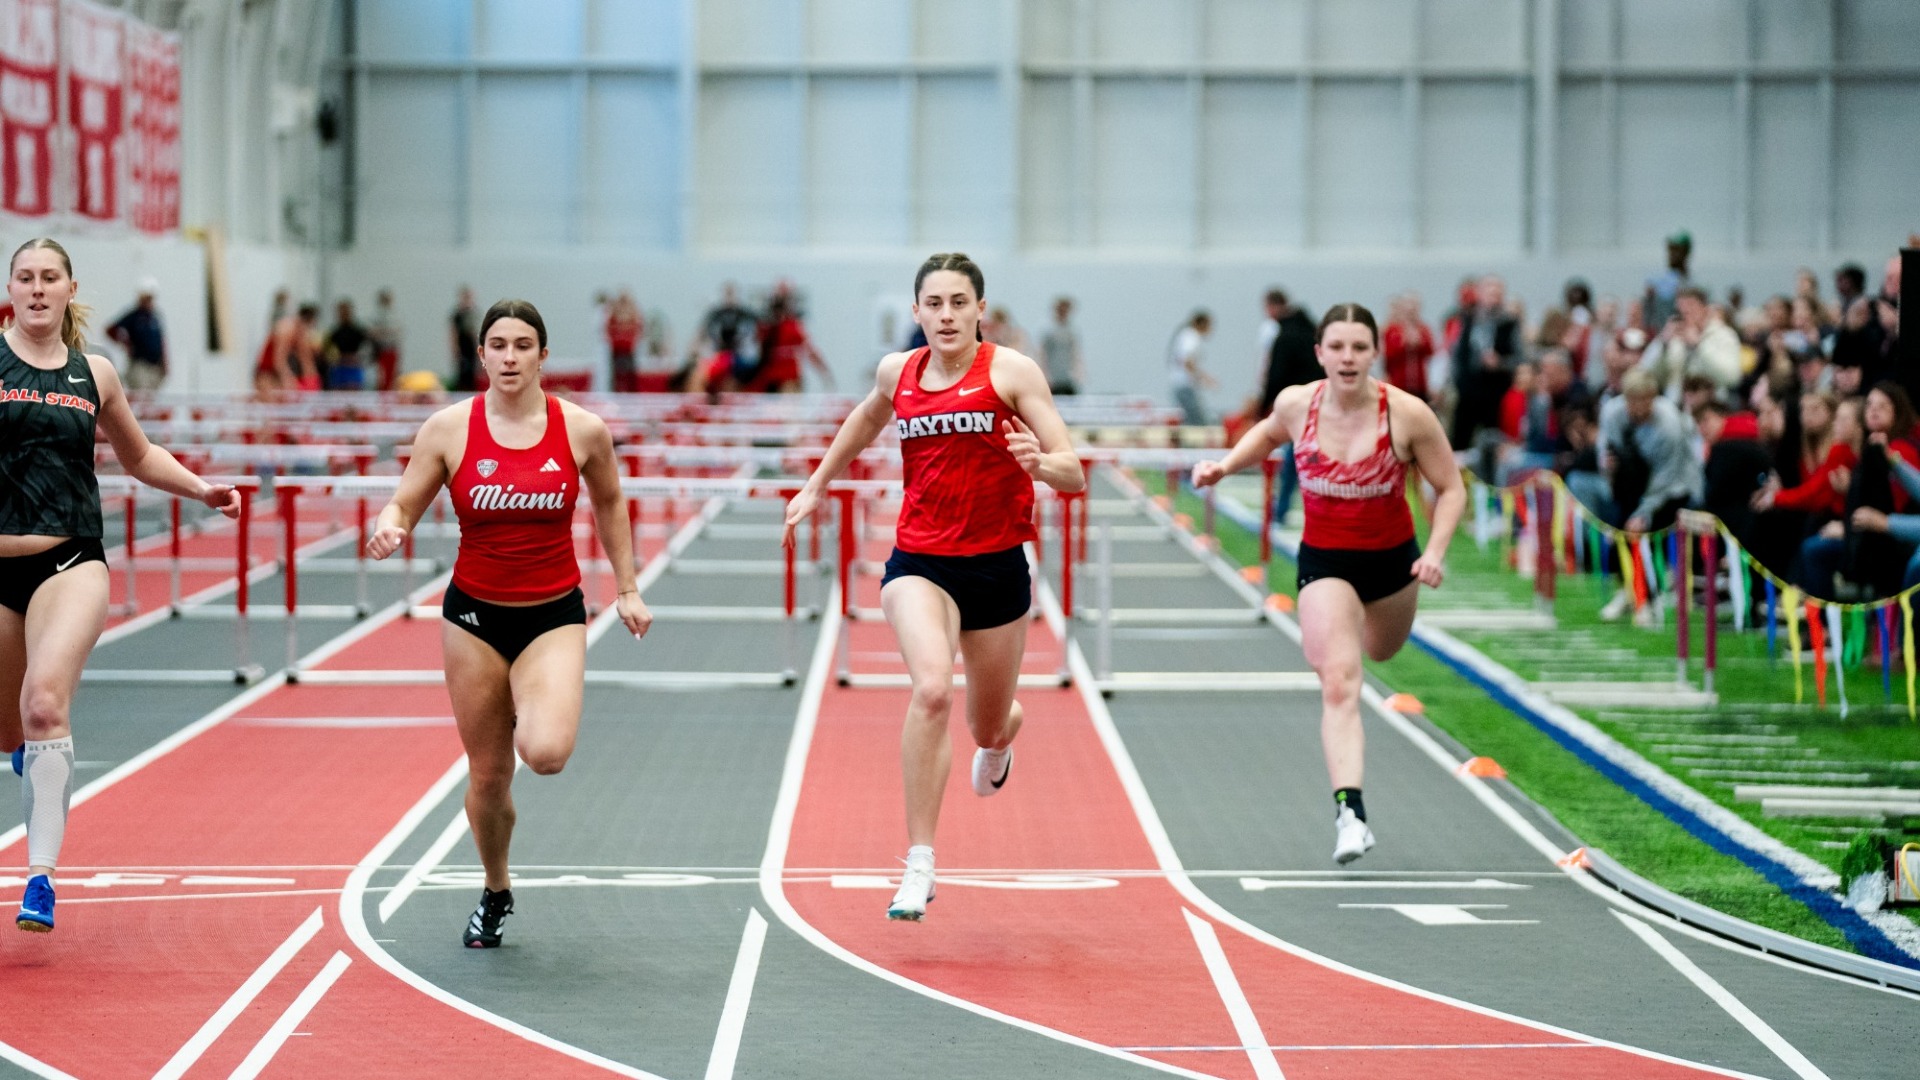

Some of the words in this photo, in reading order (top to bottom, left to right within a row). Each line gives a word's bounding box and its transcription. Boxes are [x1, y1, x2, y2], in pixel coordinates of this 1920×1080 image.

[45, 392, 95, 416] STATE
[897, 411, 995, 440] DAYTON
[469, 482, 567, 510] Miami
